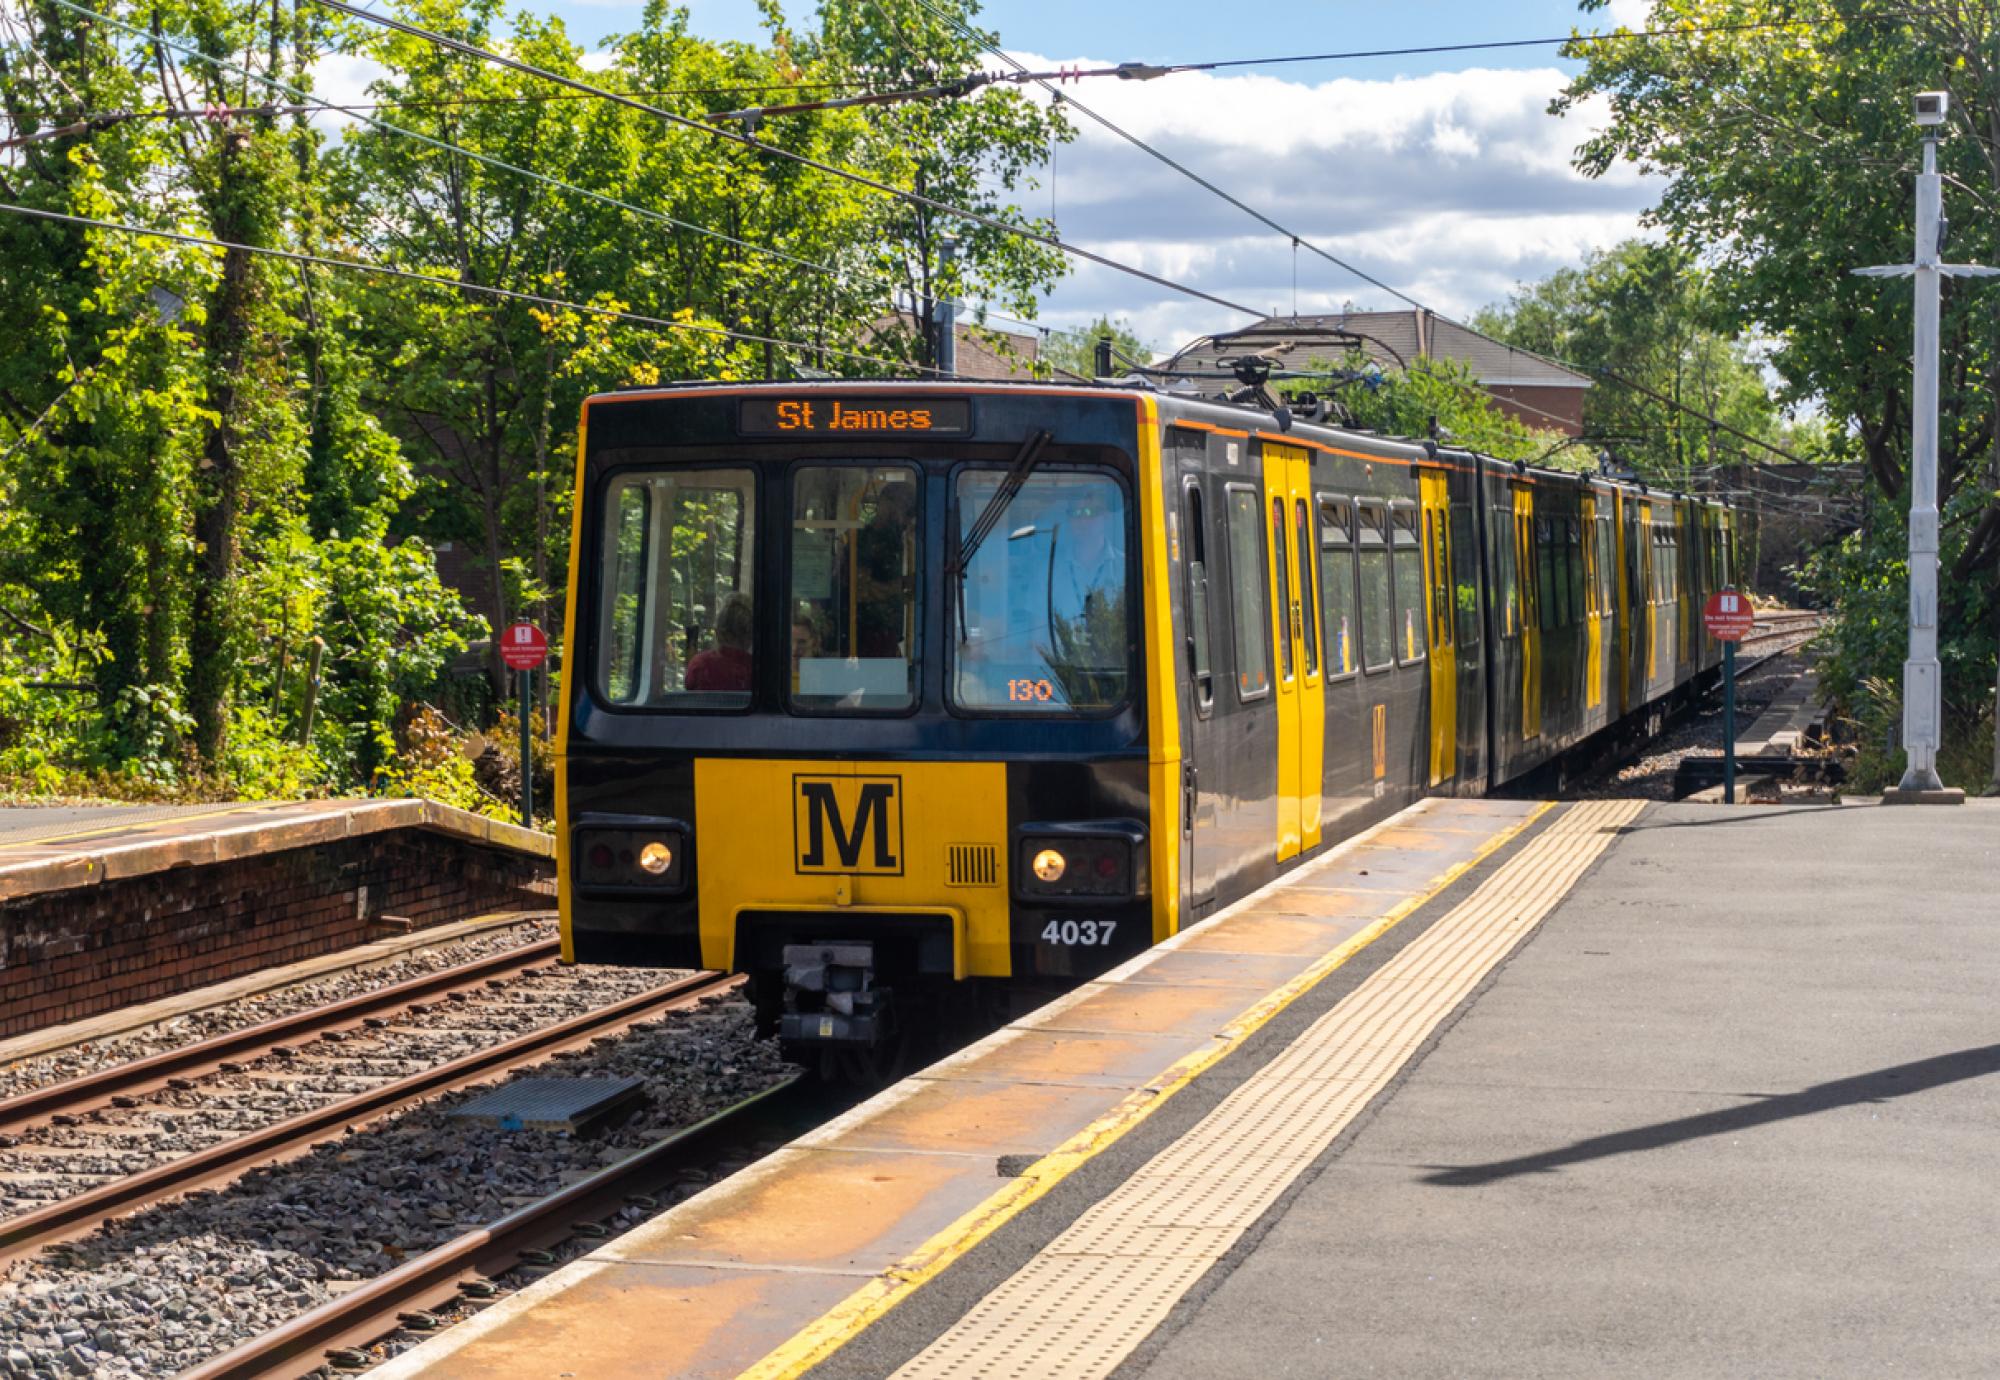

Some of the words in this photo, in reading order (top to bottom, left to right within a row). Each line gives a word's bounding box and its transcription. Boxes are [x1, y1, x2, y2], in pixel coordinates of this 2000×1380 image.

[777, 401, 815, 430] St
[829, 401, 932, 430] James
[1008, 679, 1053, 701] 130
[801, 782, 897, 868] M
[1040, 920, 1117, 945] 4037
